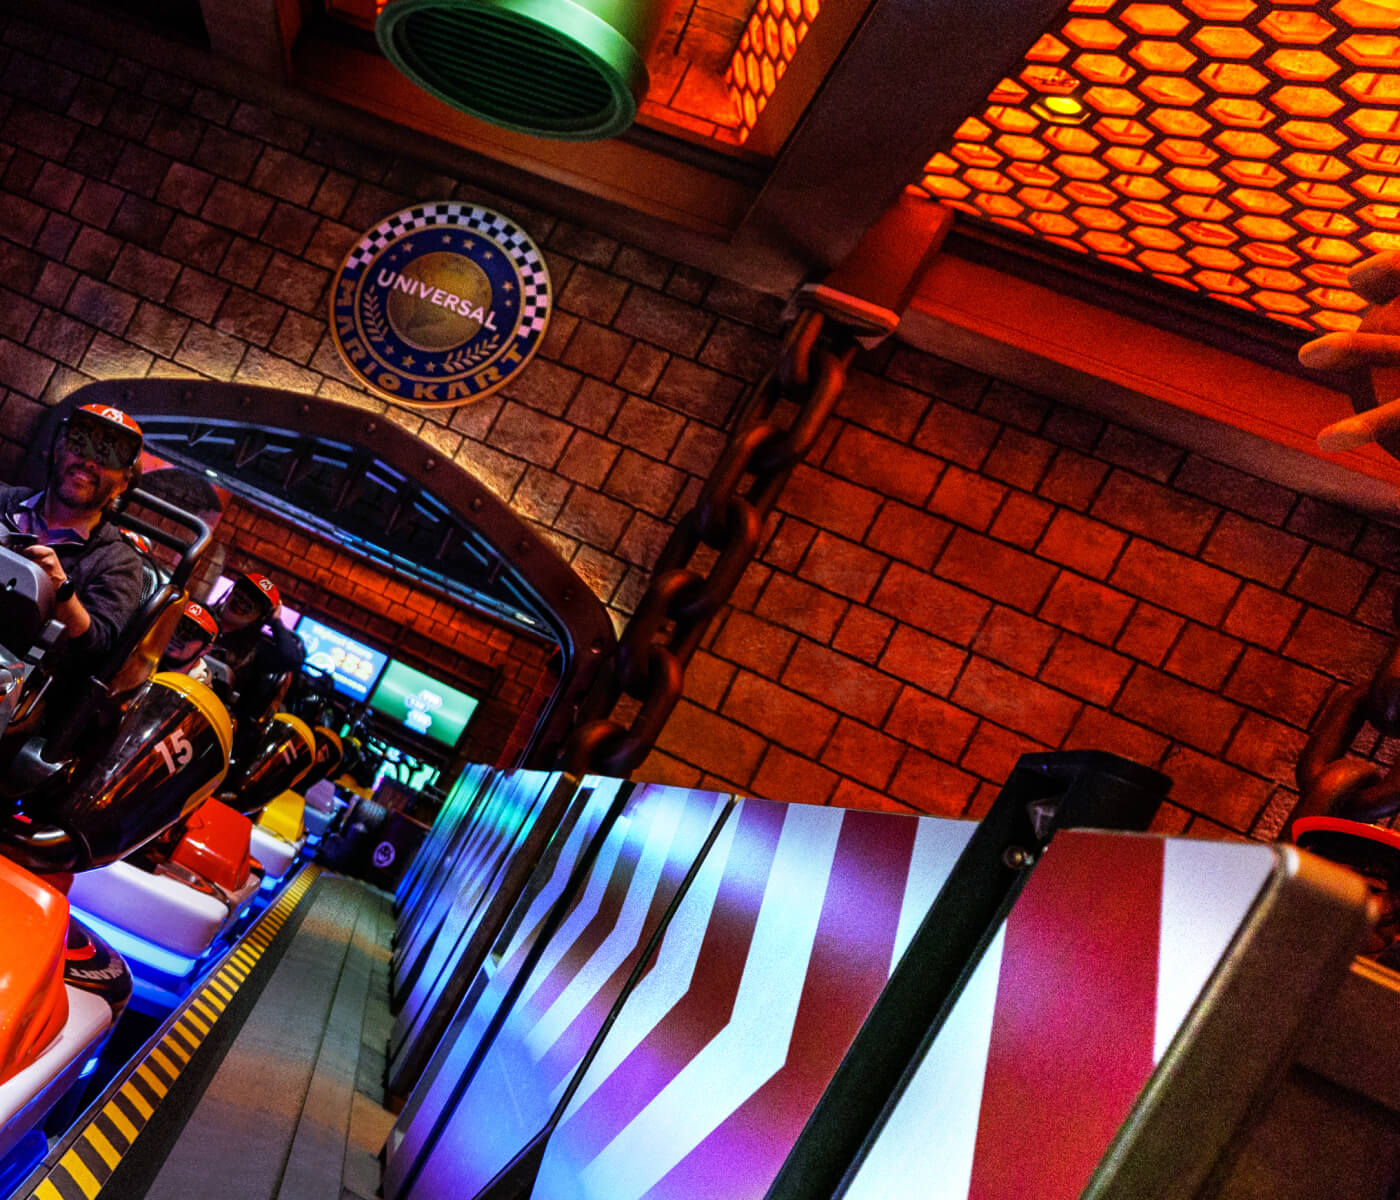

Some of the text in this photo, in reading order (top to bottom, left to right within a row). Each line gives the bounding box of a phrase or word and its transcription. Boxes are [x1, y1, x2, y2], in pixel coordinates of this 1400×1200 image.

[376, 267, 498, 332] UNIVERSAL
[336, 278, 523, 401] MARIO KART
[153, 727, 193, 775] 15
